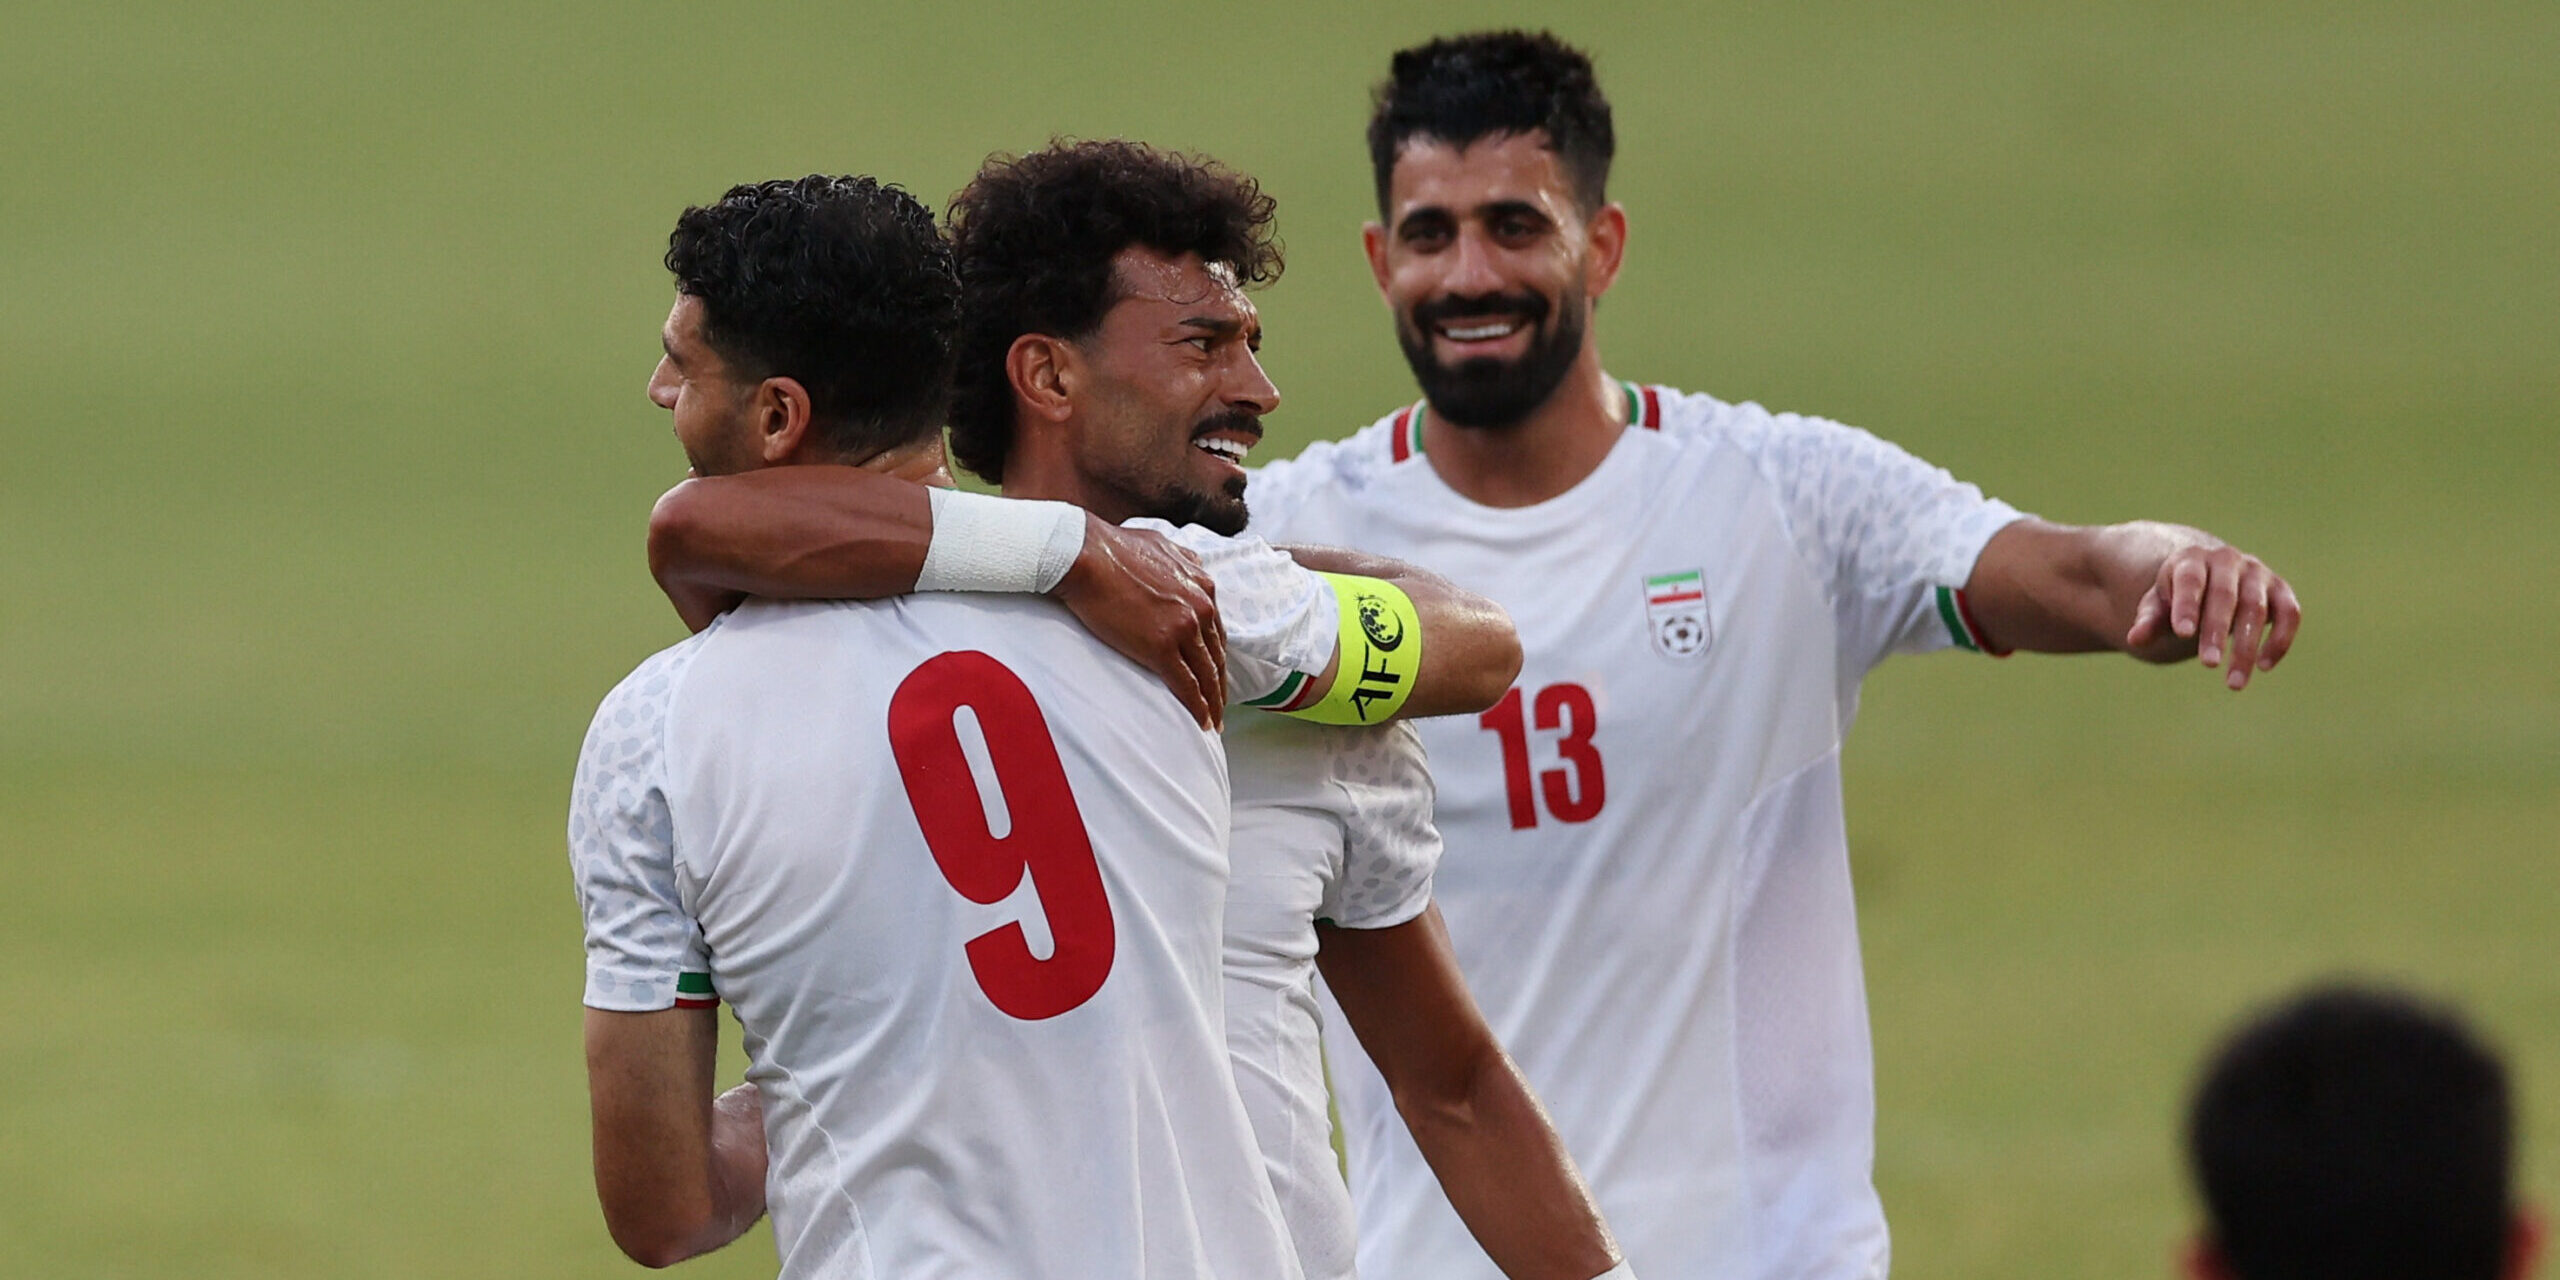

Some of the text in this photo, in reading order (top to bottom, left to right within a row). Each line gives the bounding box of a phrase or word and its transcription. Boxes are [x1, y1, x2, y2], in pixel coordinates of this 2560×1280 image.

[1348, 594, 1404, 721] AFC
[1480, 682, 1605, 829] 13
[888, 650, 1116, 1021] 9
